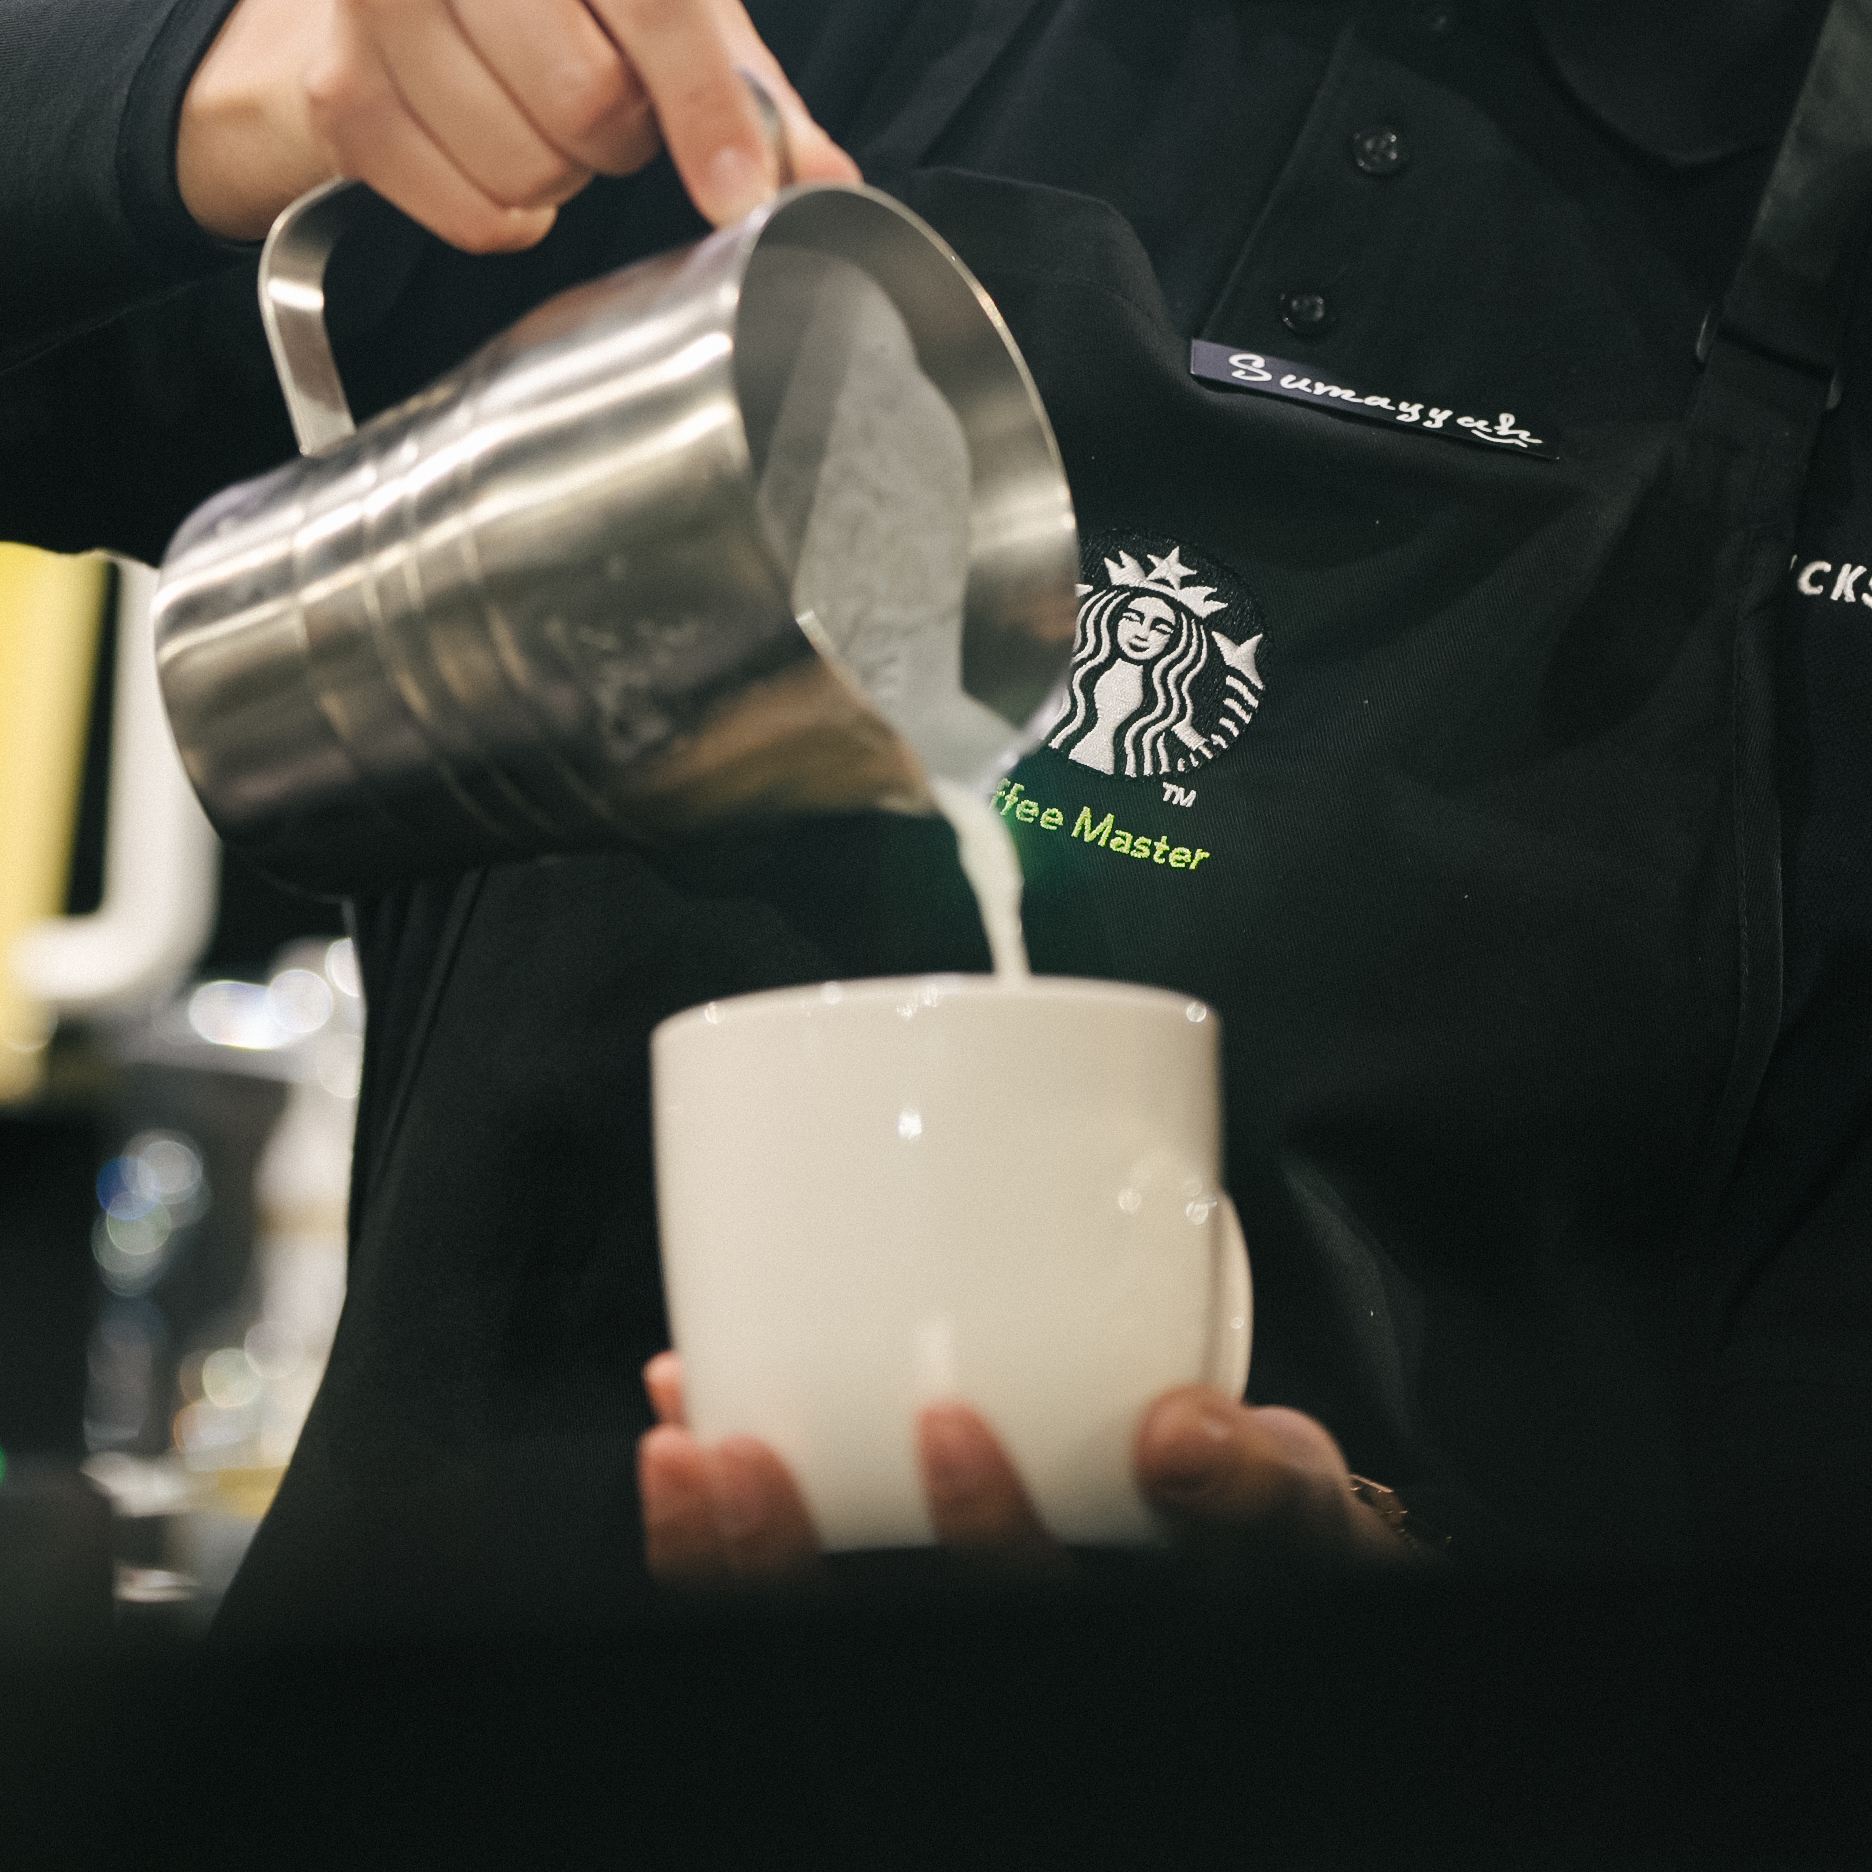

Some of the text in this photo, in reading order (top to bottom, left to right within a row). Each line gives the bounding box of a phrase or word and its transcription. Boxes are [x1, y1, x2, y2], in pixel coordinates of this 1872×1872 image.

[1228, 352, 1543, 448] Sumayyah
[989, 777, 1211, 870] ffee Master
